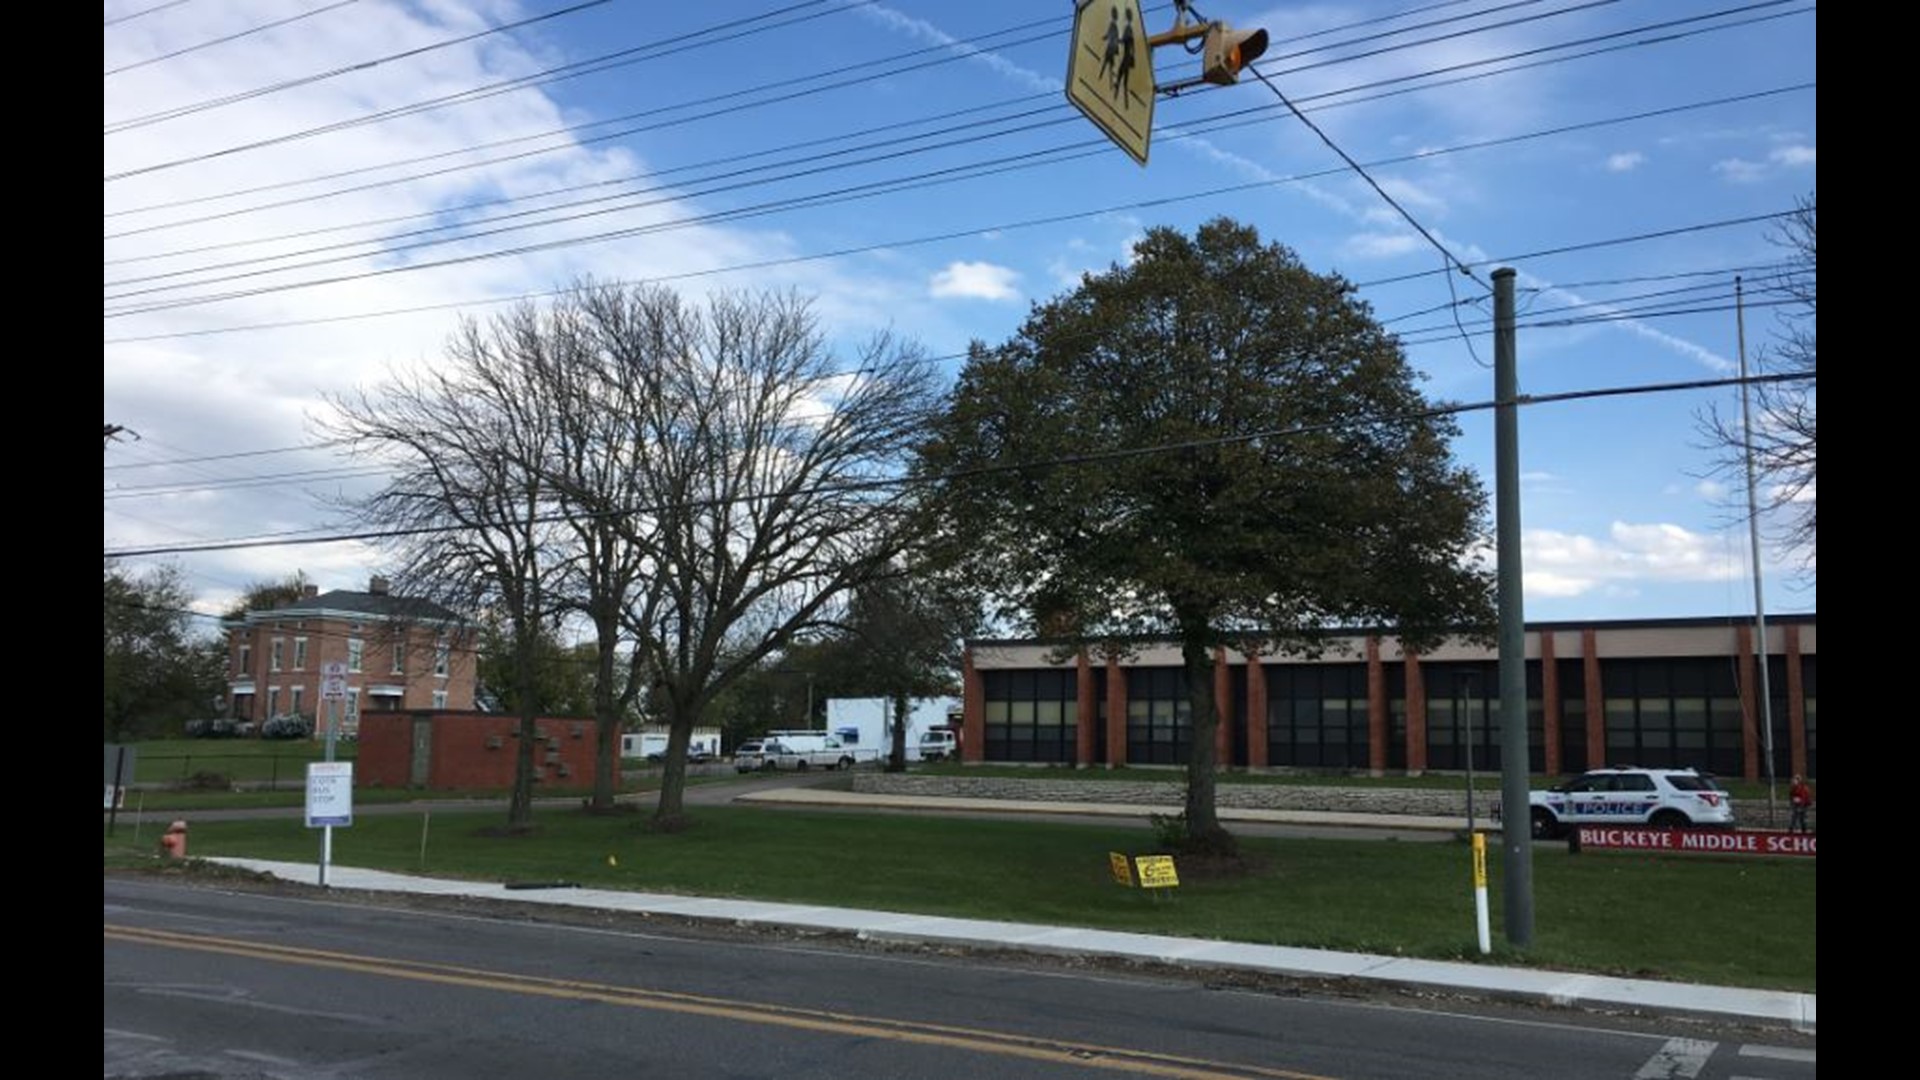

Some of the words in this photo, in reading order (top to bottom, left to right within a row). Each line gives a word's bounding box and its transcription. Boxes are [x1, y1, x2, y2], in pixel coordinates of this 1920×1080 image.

[1583, 802, 1643, 815] POLICE
[1580, 829, 1672, 847] BUCKEYE
[1682, 833, 1757, 850] MIDDLE
